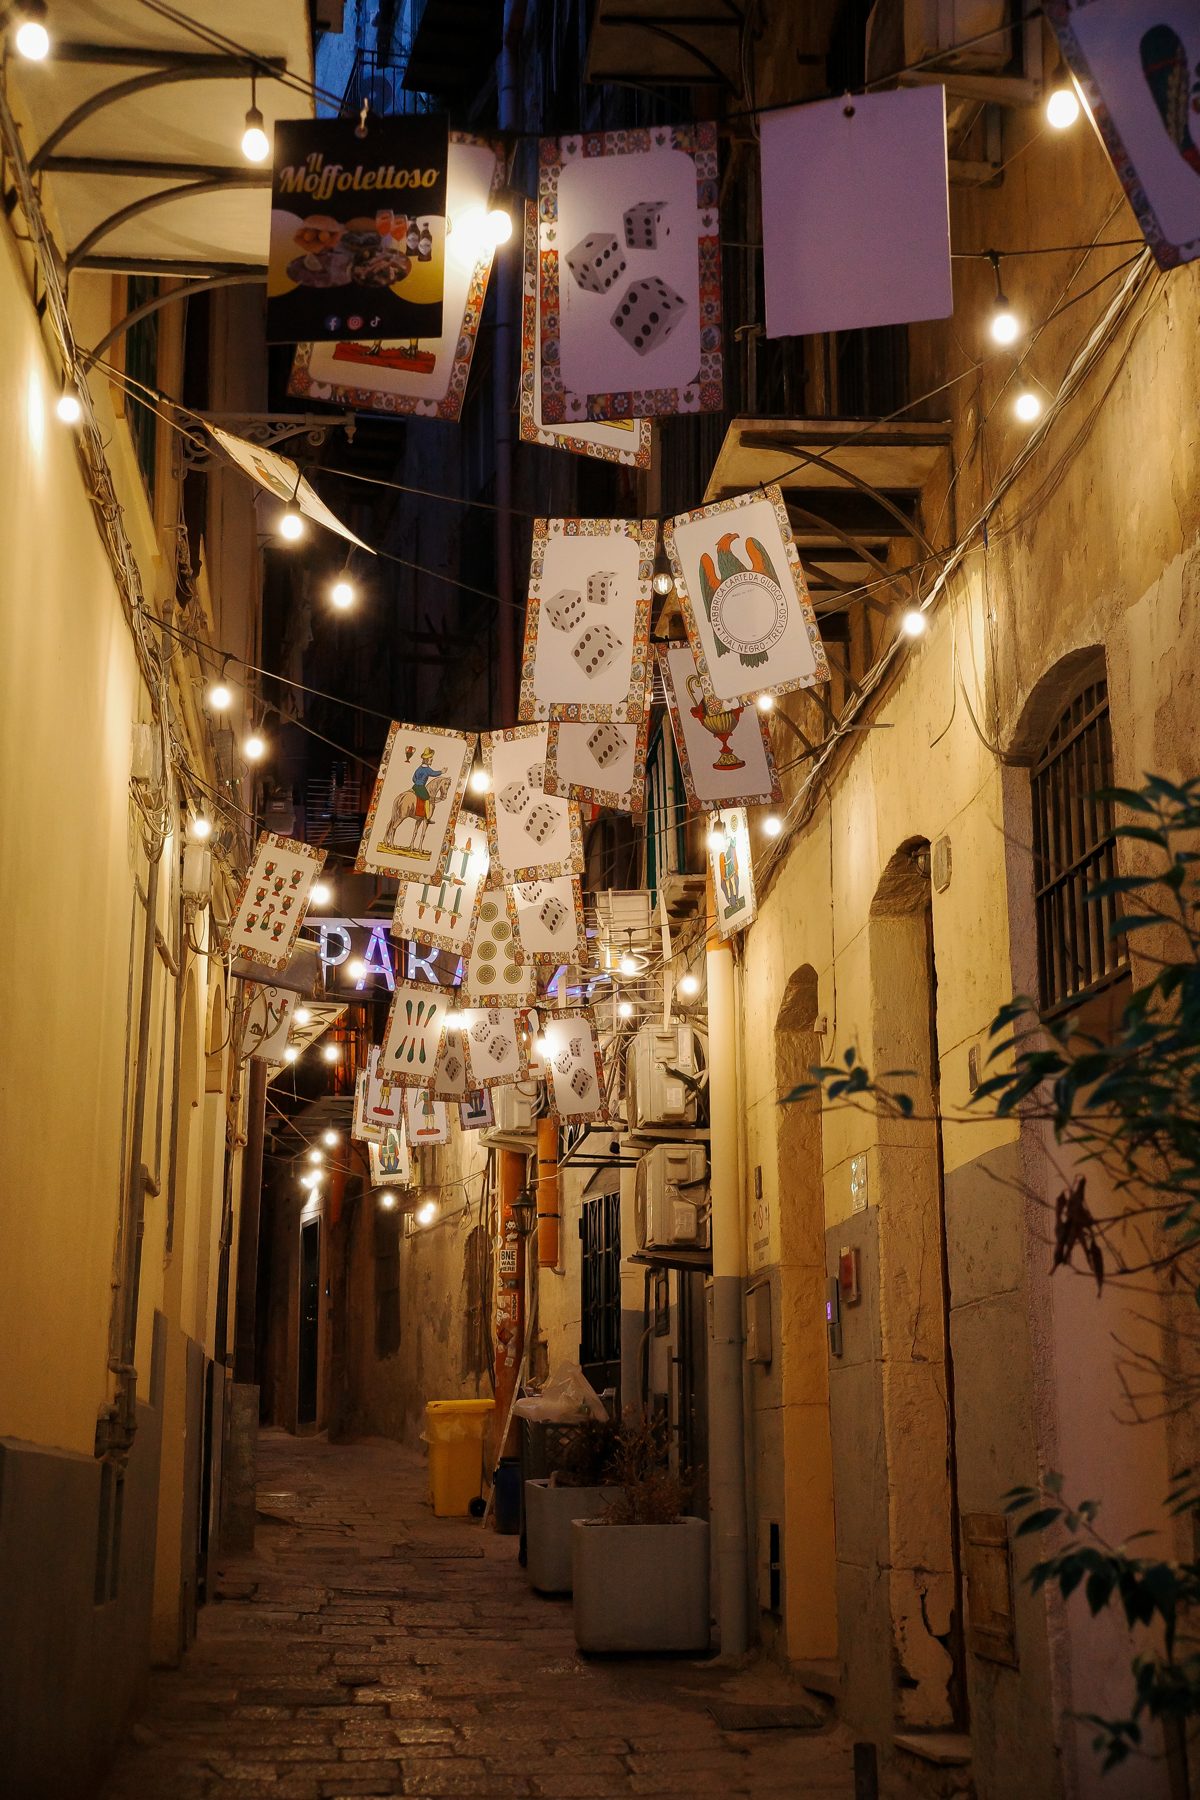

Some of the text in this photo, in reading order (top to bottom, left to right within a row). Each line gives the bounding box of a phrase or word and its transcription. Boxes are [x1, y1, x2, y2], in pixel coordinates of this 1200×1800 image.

[306, 152, 324, 173] Il
[279, 164, 440, 200] Moffolettoso
[711, 588, 726, 628] FABBRICA
[760, 576, 783, 601] GIUOCO
[722, 636, 735, 649] DAL
